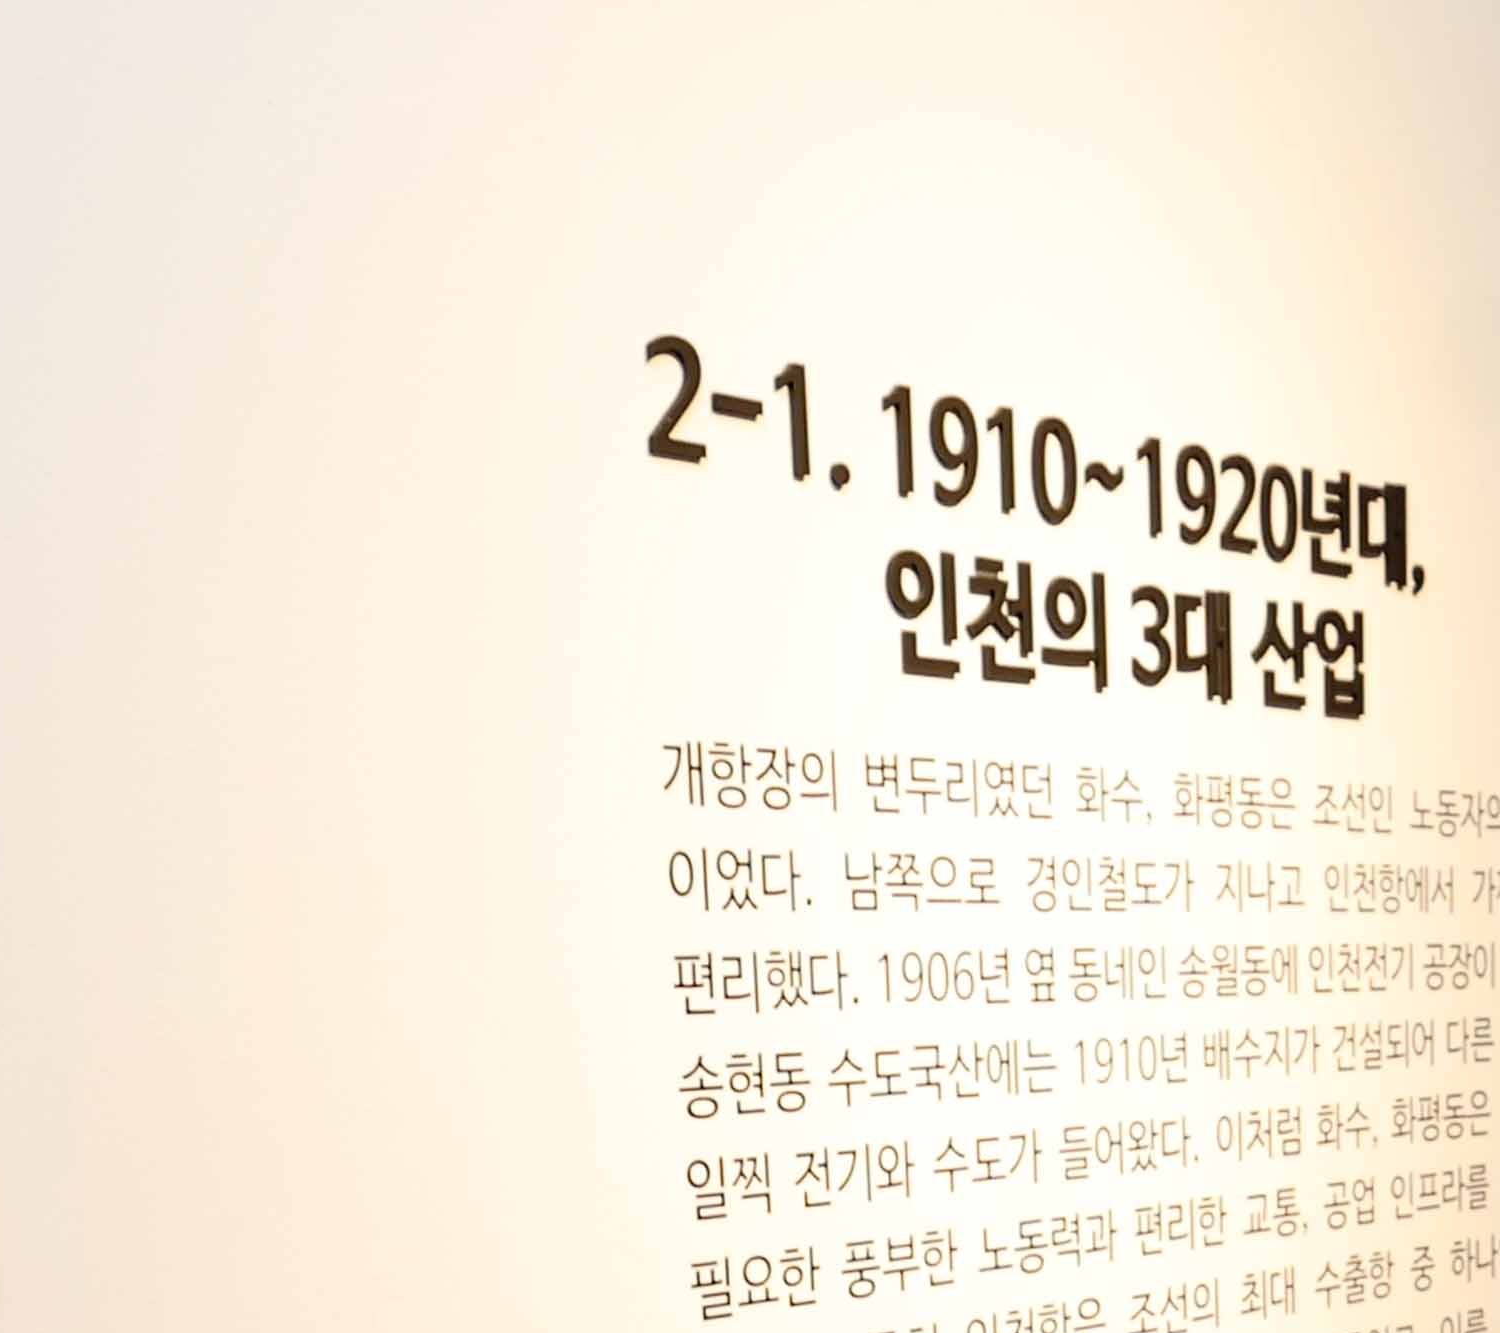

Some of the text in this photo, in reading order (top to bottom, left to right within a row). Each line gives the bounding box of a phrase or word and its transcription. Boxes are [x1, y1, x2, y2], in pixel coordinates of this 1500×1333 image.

[644, 334, 1427, 597] 2-1. 1910~1920년대,
[883, 547, 1367, 721] 인천의 3대 산업
[662, 741, 839, 813] 개항장의
[864, 754, 1054, 821] 변두리였던
[1074, 766, 1154, 825] 화수,
[1173, 771, 1297, 831] 화평동은
[1311, 782, 1394, 836] 조선인
[667, 847, 813, 913] 이었다.
[843, 852, 1002, 912] 남쪽으로
[1026, 855, 1195, 914] 경인철도가
[1215, 859, 1306, 914] 지나고
[1323, 862, 1456, 916] 인천항에서
[672, 950, 860, 1016] 편리했다.
[878, 949, 1011, 1006] 1906년
[1023, 948, 1056, 1004] 옆
[1068, 945, 1168, 1004] 동네인
[1178, 942, 1300, 1000] 송월동에
[1307, 942, 1416, 995] 인천전기
[1422, 940, 1497, 992] 공장이
[678, 1051, 812, 1120] 송현동
[827, 1038, 1058, 1108] 수도국산에는
[1074, 1032, 1189, 1086] 1910년
[1202, 1023, 1322, 1082] 배수지가
[1331, 1018, 1436, 1073] 건설되어
[1445, 1015, 1496, 1066] 다른
[685, 1152, 772, 1222] 일찍
[794, 1139, 915, 1209] 전기와
[933, 1128, 1043, 1193] 수도가
[1058, 1115, 1200, 1182] 들어왔다.
[1215, 1106, 1302, 1163] 이처럼
[1316, 1102, 1380, 1151] 화수,
[1390, 1088, 1493, 1145] 화평동은
[690, 1245, 821, 1322] 필요한
[841, 1228, 959, 1300] 풍부한
[978, 1208, 1118, 1276] 노동력과
[1134, 1195, 1228, 1258] 편리한
[1242, 1186, 1309, 1239] 교통,
[1322, 1177, 1376, 1232] 공업
[1389, 1162, 1491, 1221] 인프라를
[1240, 1264, 1297, 1321] 최대
[1314, 1250, 1395, 1310] 수출항
[1409, 1244, 1438, 1294] 중
